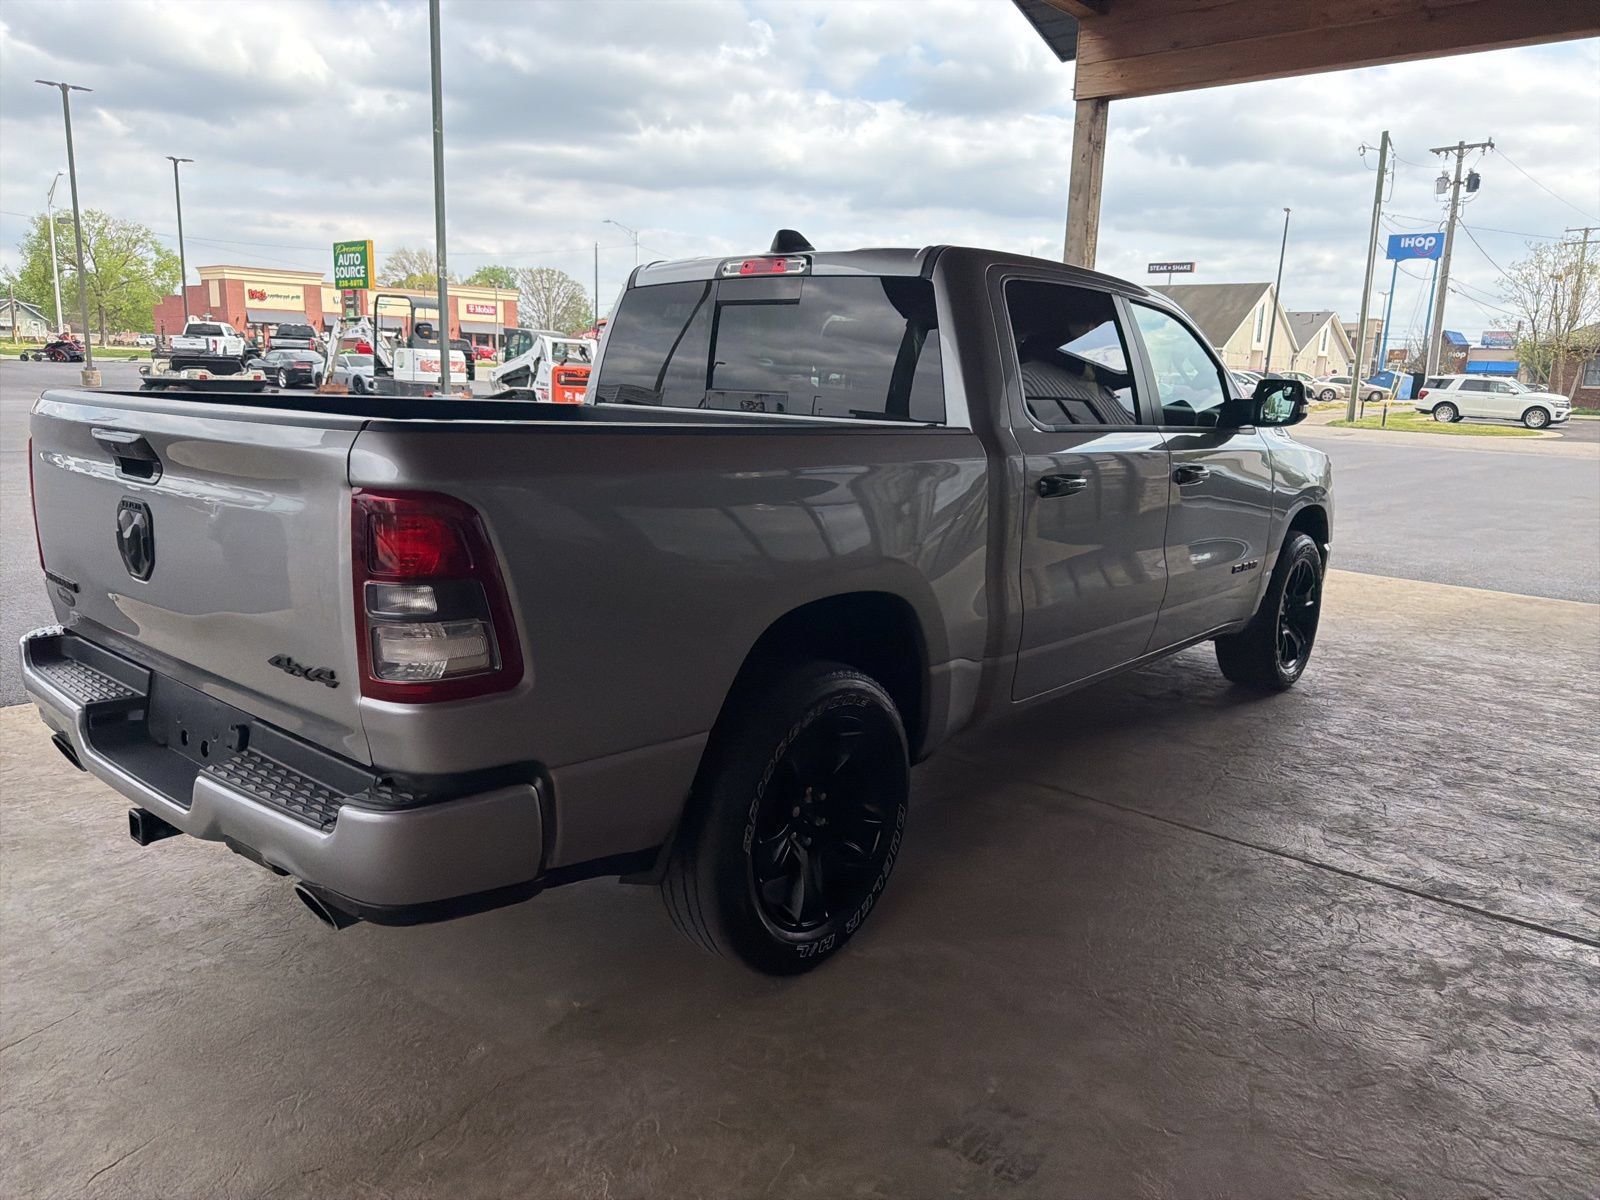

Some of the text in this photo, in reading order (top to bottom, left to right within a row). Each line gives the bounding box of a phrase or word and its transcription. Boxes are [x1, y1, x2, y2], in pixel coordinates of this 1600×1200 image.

[1400, 236, 1436, 250] IHOP
[337, 253, 361, 266] AUTO
[335, 266, 366, 278] SOURCE
